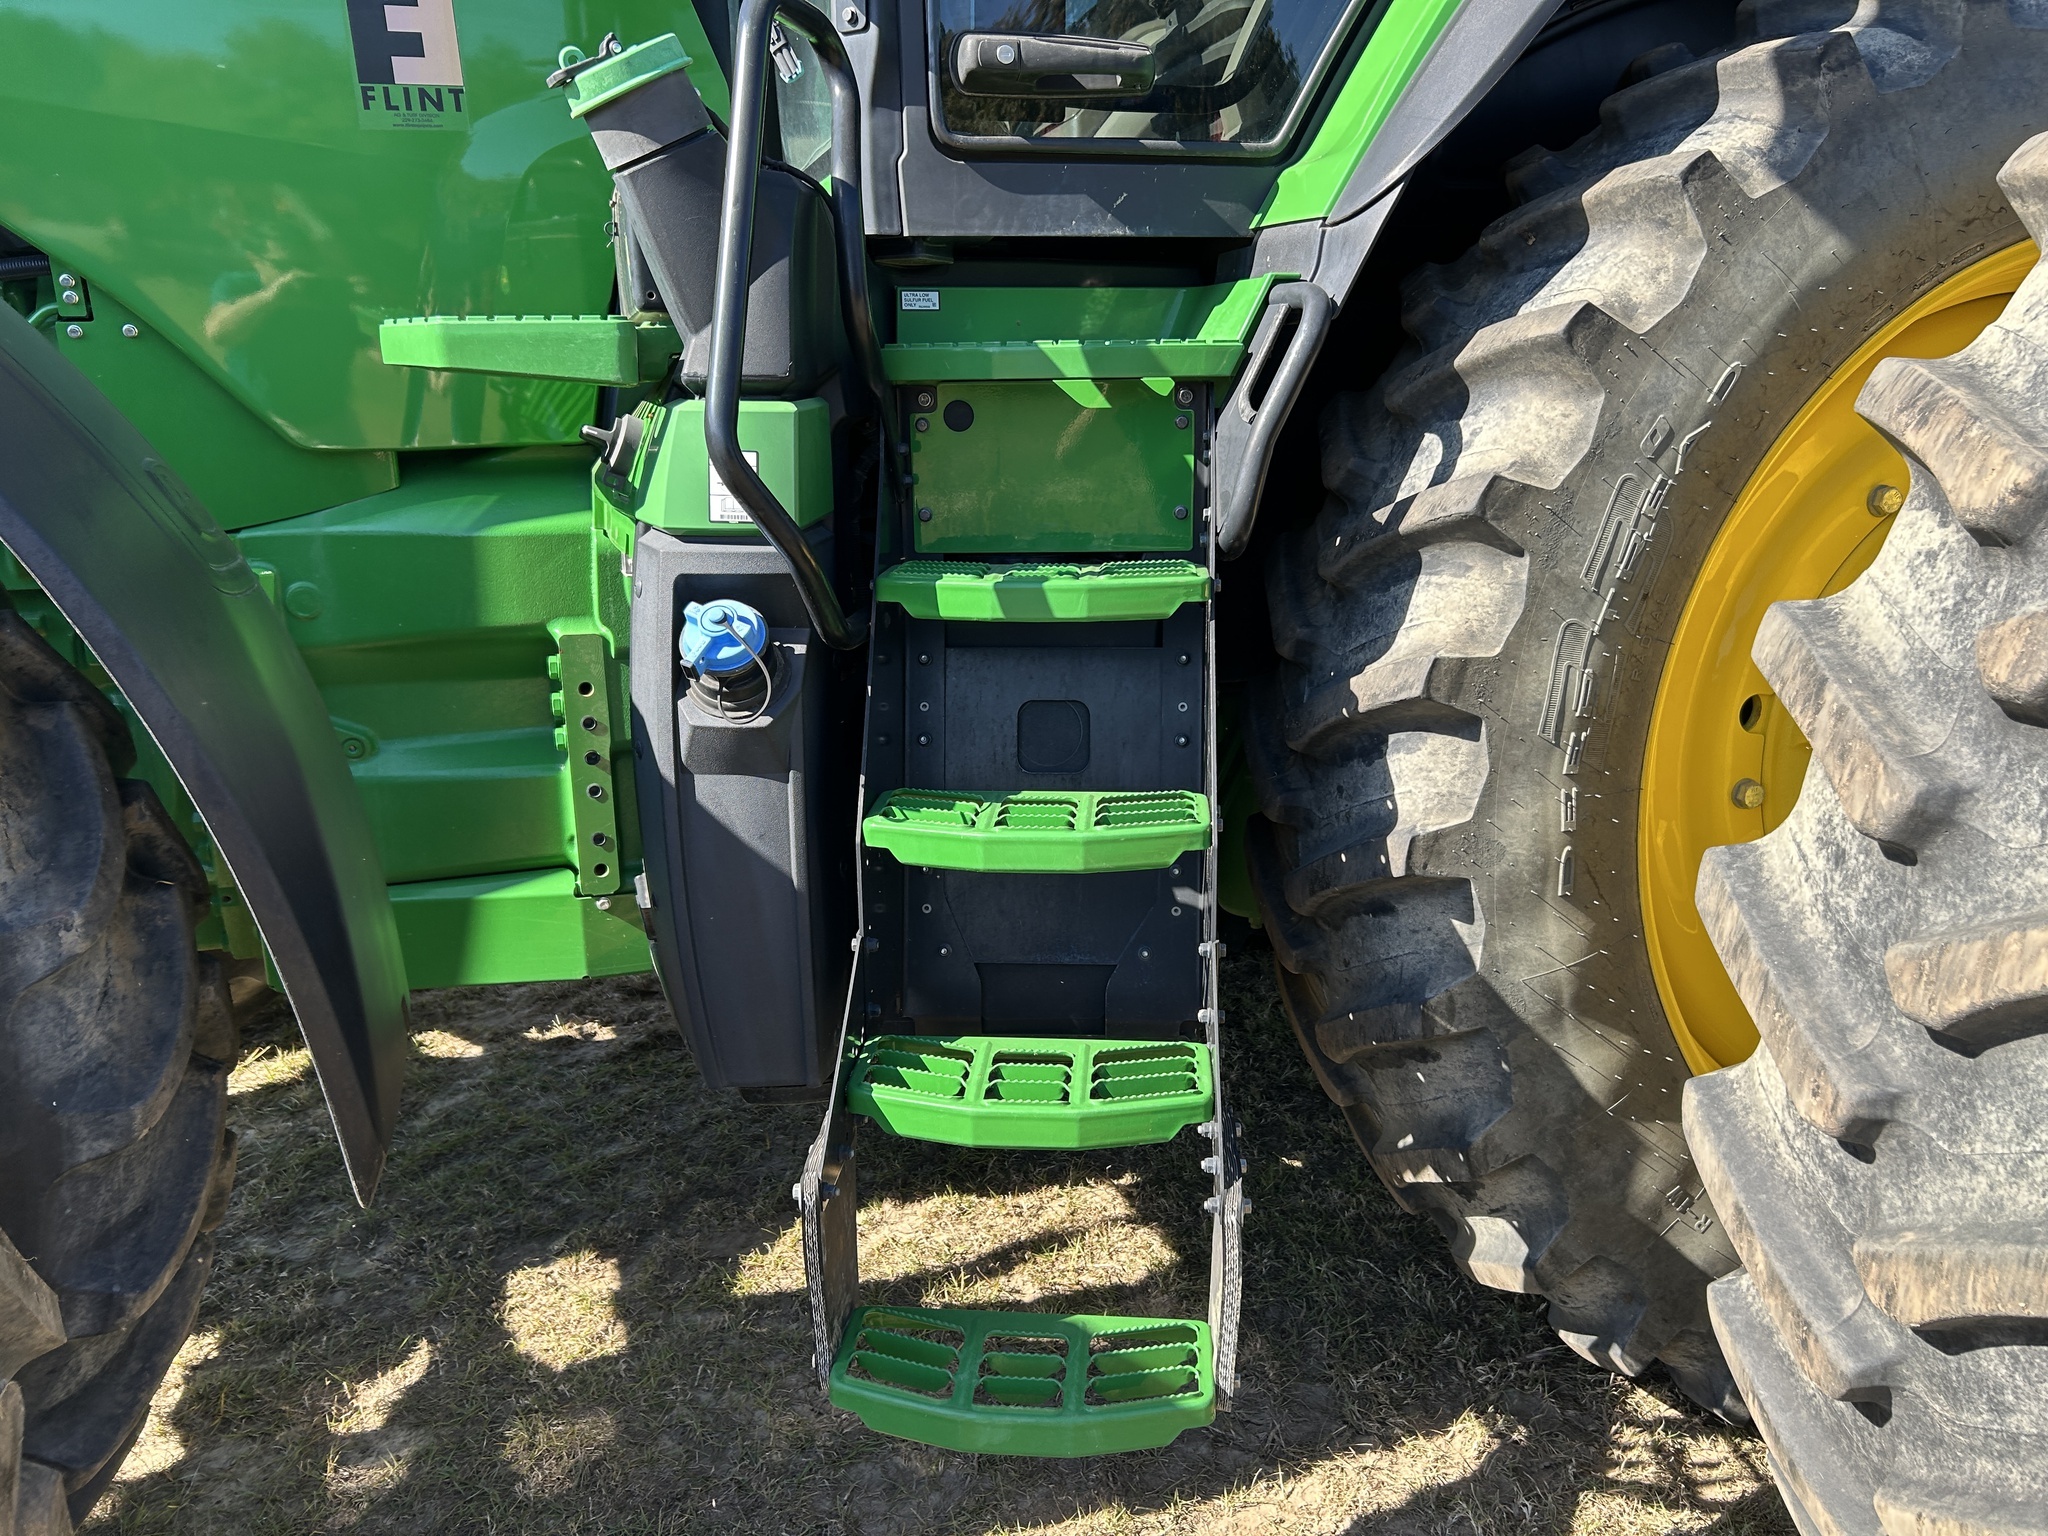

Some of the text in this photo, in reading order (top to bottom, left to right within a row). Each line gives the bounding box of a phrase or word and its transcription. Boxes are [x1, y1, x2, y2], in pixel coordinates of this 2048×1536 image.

[360, 86, 465, 112] FLINT
[1557, 361, 1742, 898] DEEP TREAD
[1631, 591, 1671, 682] RADIAL
